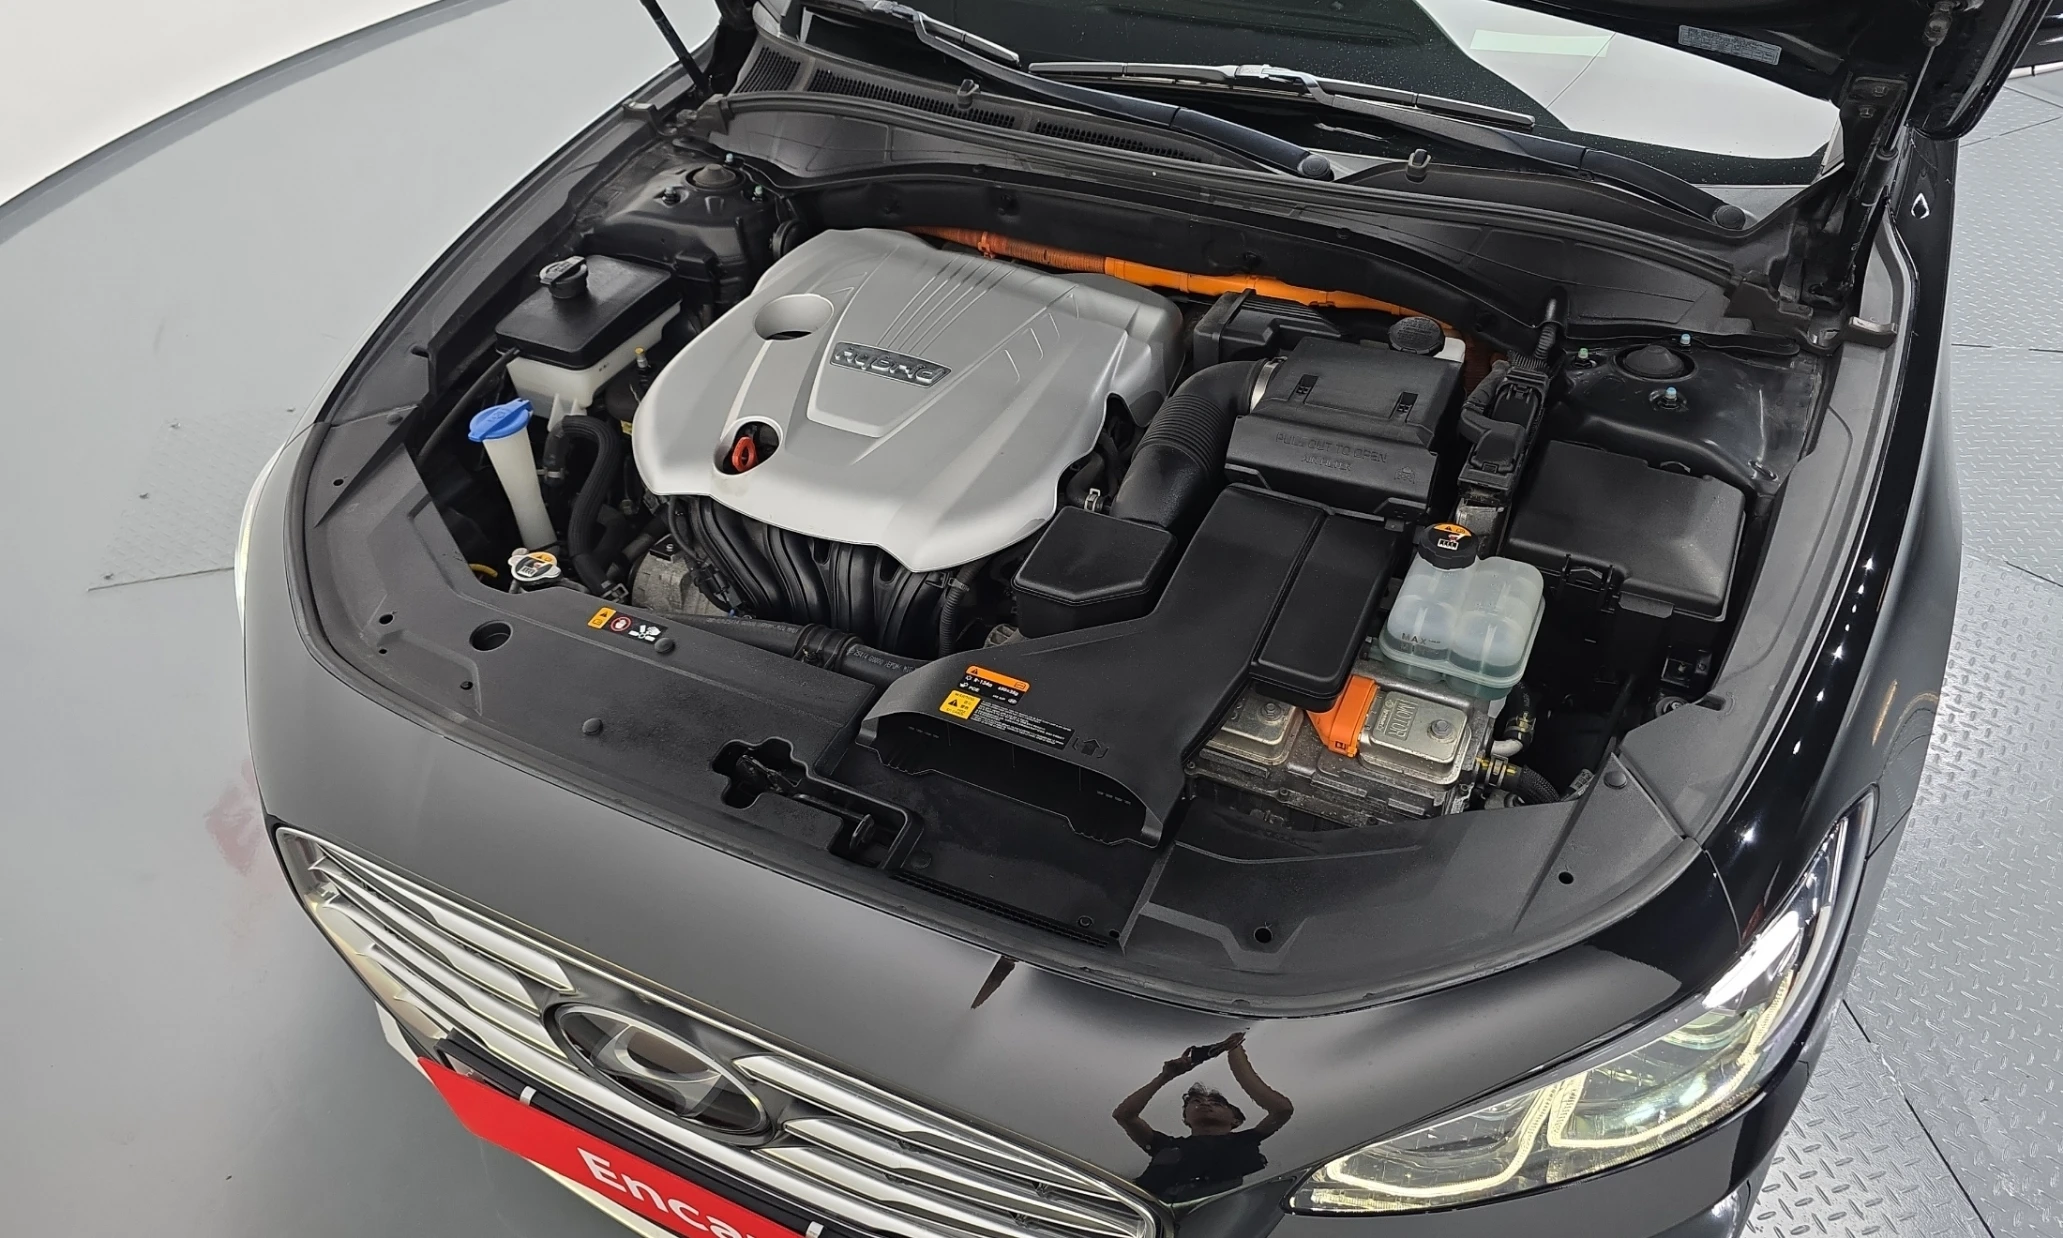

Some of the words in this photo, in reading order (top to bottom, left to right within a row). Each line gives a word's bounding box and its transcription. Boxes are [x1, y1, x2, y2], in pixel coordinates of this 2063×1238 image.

[1307, 438, 1333, 452] OUT
[1336, 443, 1350, 456] TO
[1353, 448, 1388, 464] OPEN
[1401, 632, 1428, 645] MAX
[1388, 702, 1416, 738] MOTOR
[577, 1146, 755, 1238] Enca
